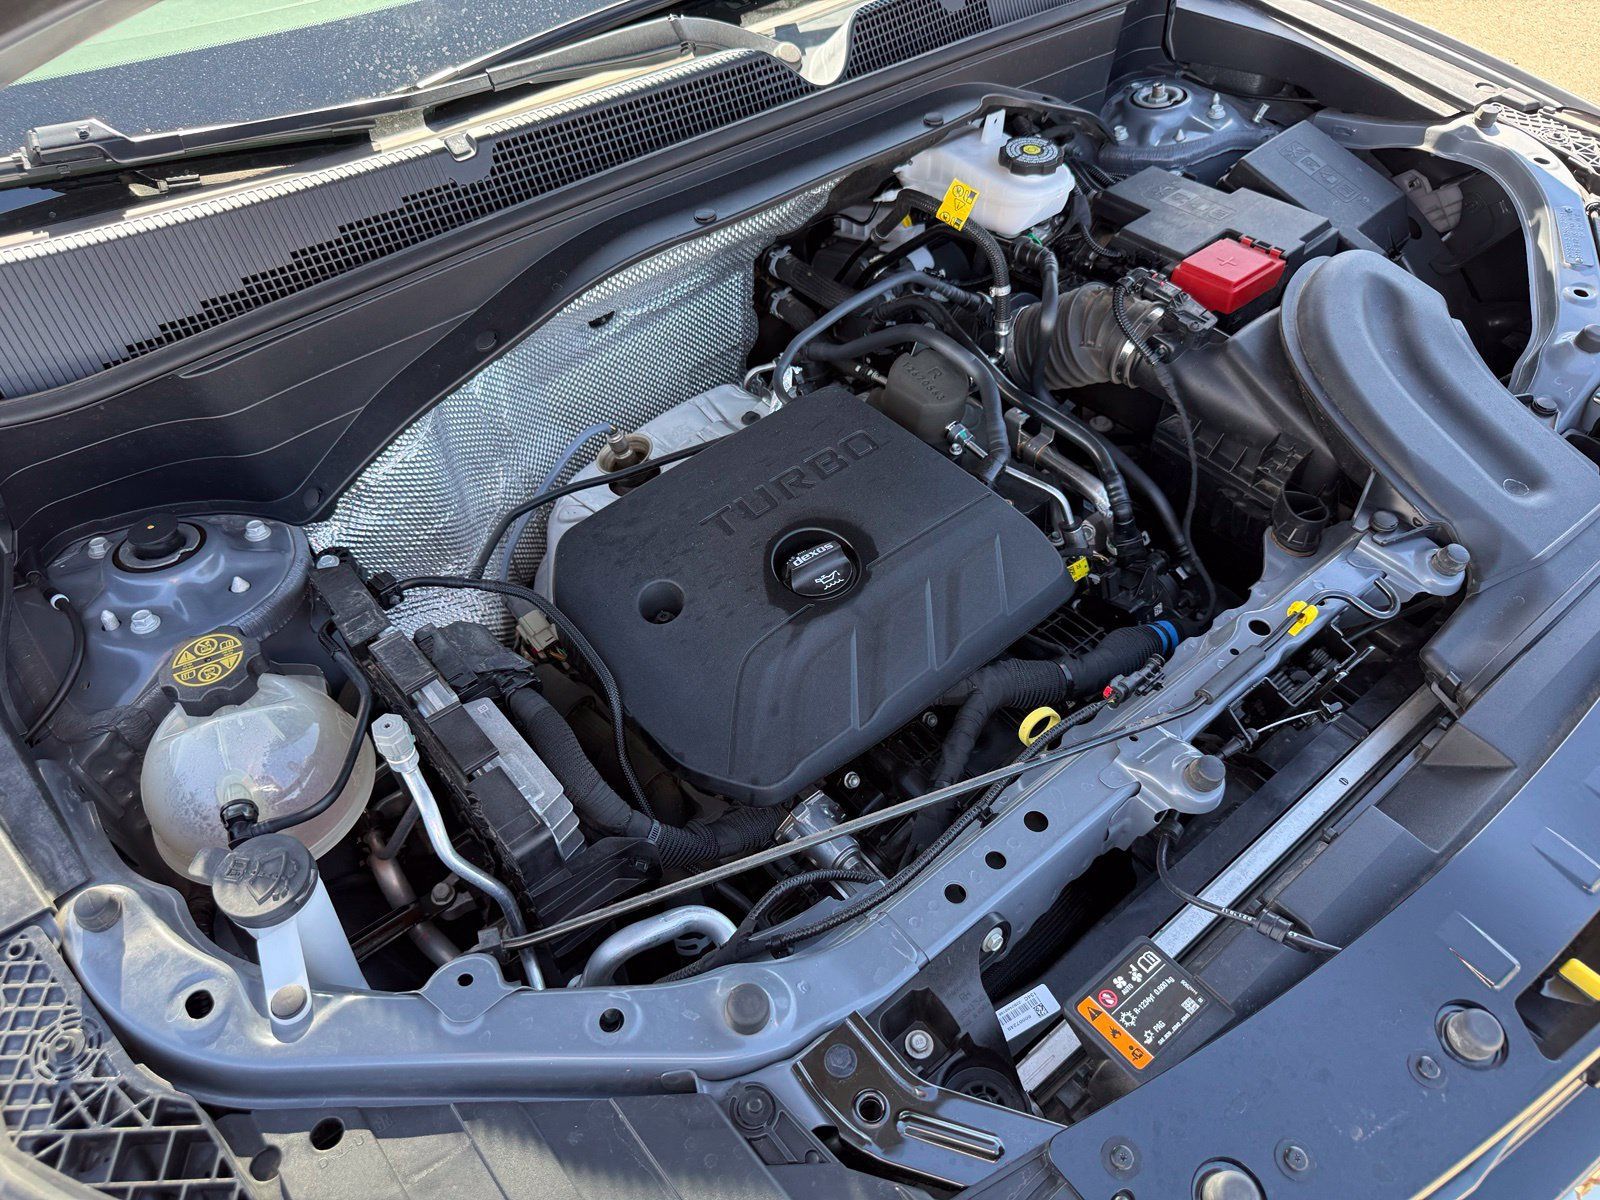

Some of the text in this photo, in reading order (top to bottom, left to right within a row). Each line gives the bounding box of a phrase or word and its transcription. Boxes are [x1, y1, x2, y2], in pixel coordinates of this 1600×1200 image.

[699, 429, 879, 536] TURBO
[792, 543, 834, 567] dexos
[1121, 983, 1134, 996] AUTO
[1133, 994, 1156, 1015] R-1234yf
[1165, 976, 1176, 988] kg
[1152, 1020, 1166, 1033] PAG
